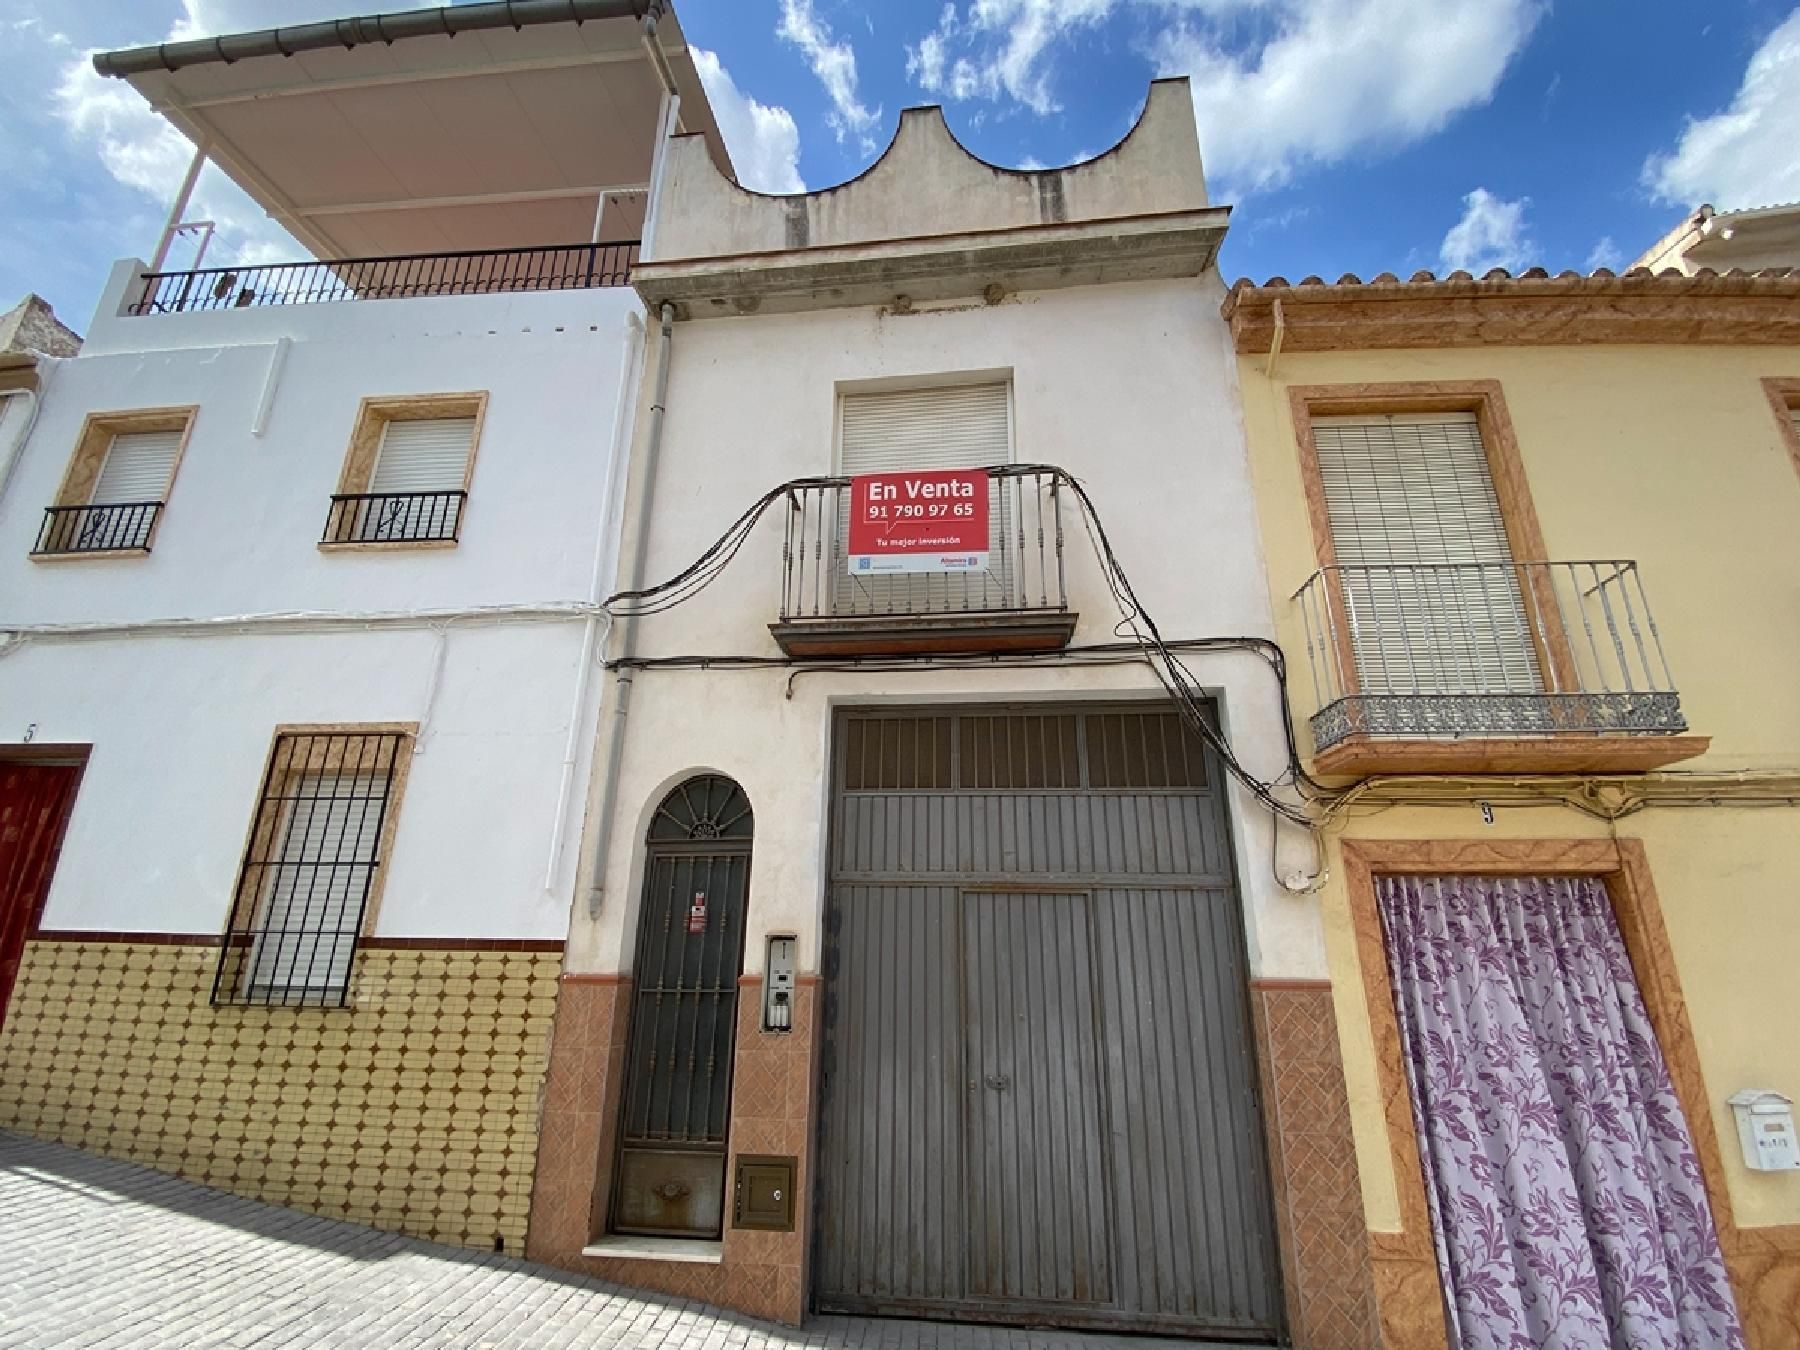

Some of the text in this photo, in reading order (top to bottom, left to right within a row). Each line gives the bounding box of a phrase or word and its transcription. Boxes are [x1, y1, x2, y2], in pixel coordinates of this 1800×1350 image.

[869, 479, 973, 501] En Venta
[869, 502, 973, 518] 91 790 97 65
[876, 536, 961, 548] Tu mejor inversión
[23, 723, 36, 743] 5
